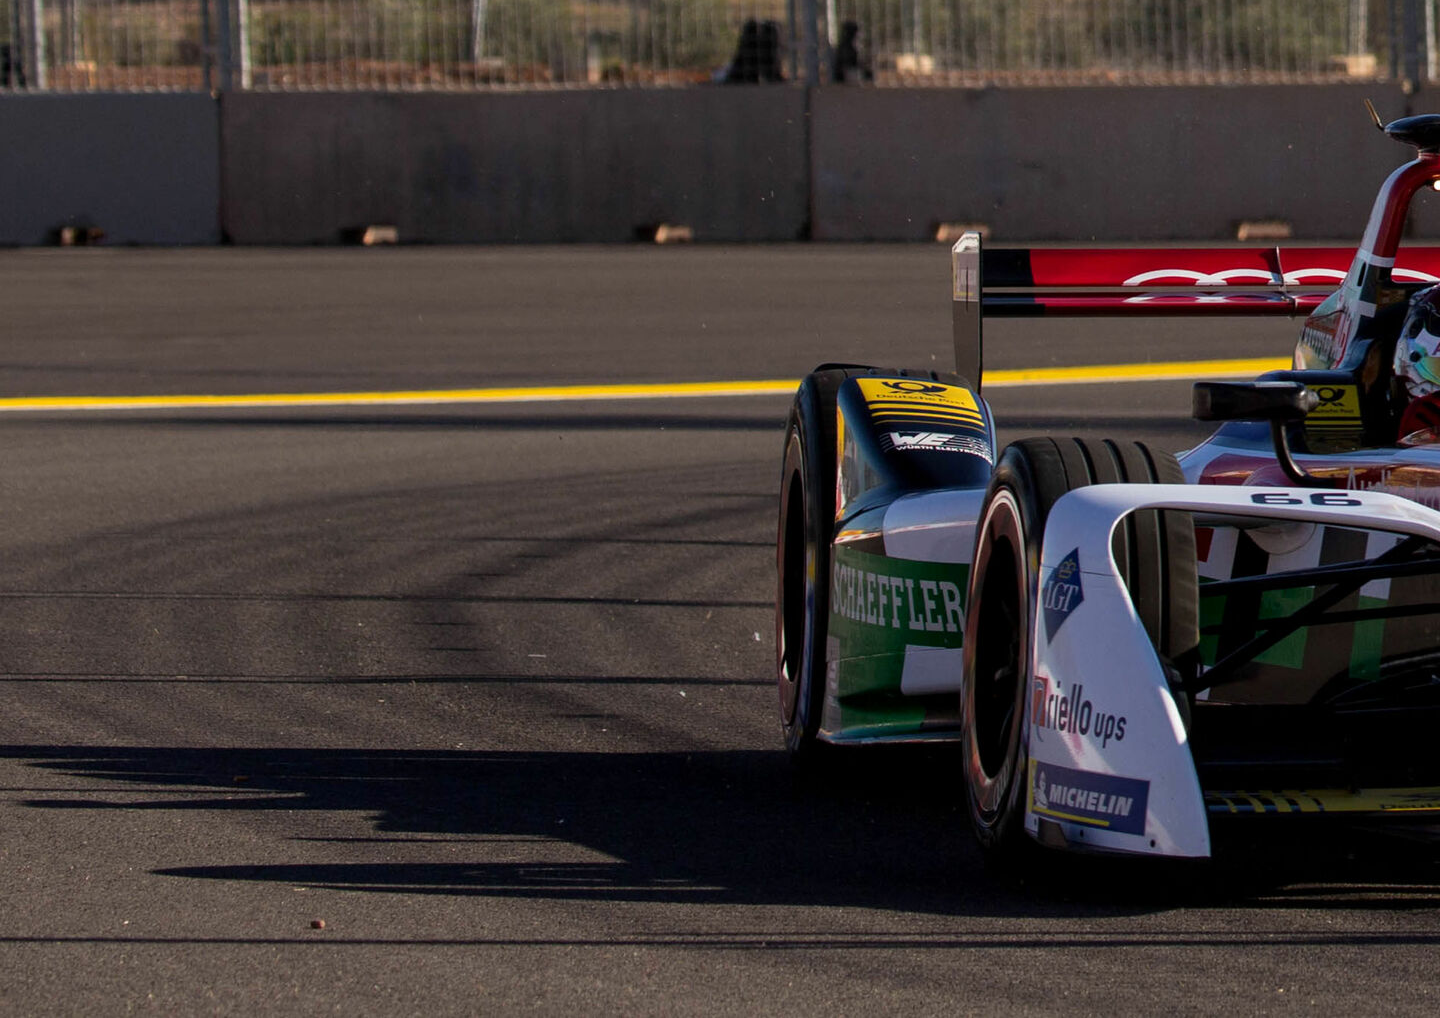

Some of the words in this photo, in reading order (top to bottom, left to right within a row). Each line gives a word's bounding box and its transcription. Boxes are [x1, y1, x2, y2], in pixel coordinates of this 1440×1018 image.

[889, 432, 955, 446] WE
[896, 443, 933, 451] WÜRTH
[1251, 492, 1363, 507] 66
[833, 561, 965, 633] SCHAEFFLER
[1044, 581, 1079, 613] LGT
[1047, 680, 1093, 736] riello
[1095, 711, 1127, 748] ups
[1050, 783, 1133, 816] MICHELIN
